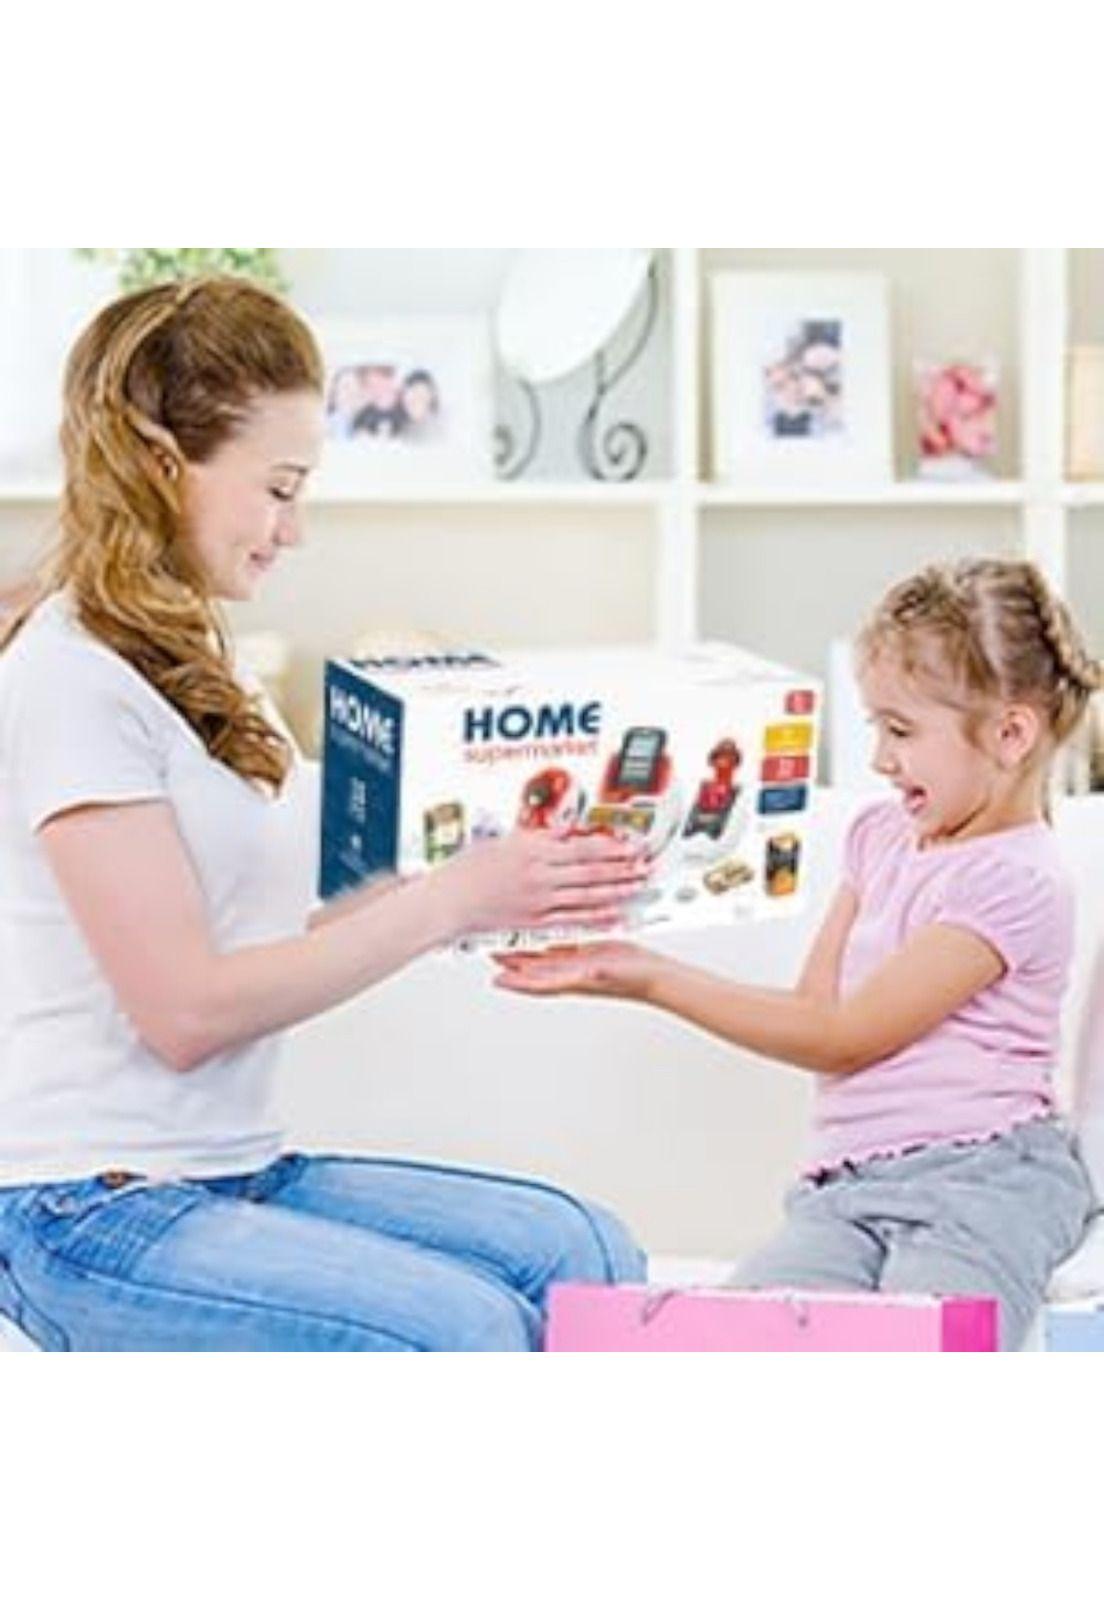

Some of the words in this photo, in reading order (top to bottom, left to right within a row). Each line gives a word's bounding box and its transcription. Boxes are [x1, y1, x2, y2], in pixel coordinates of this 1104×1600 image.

[329, 684, 395, 756] HOME
[463, 701, 602, 742] HOME
[463, 739, 599, 766] supermarket
